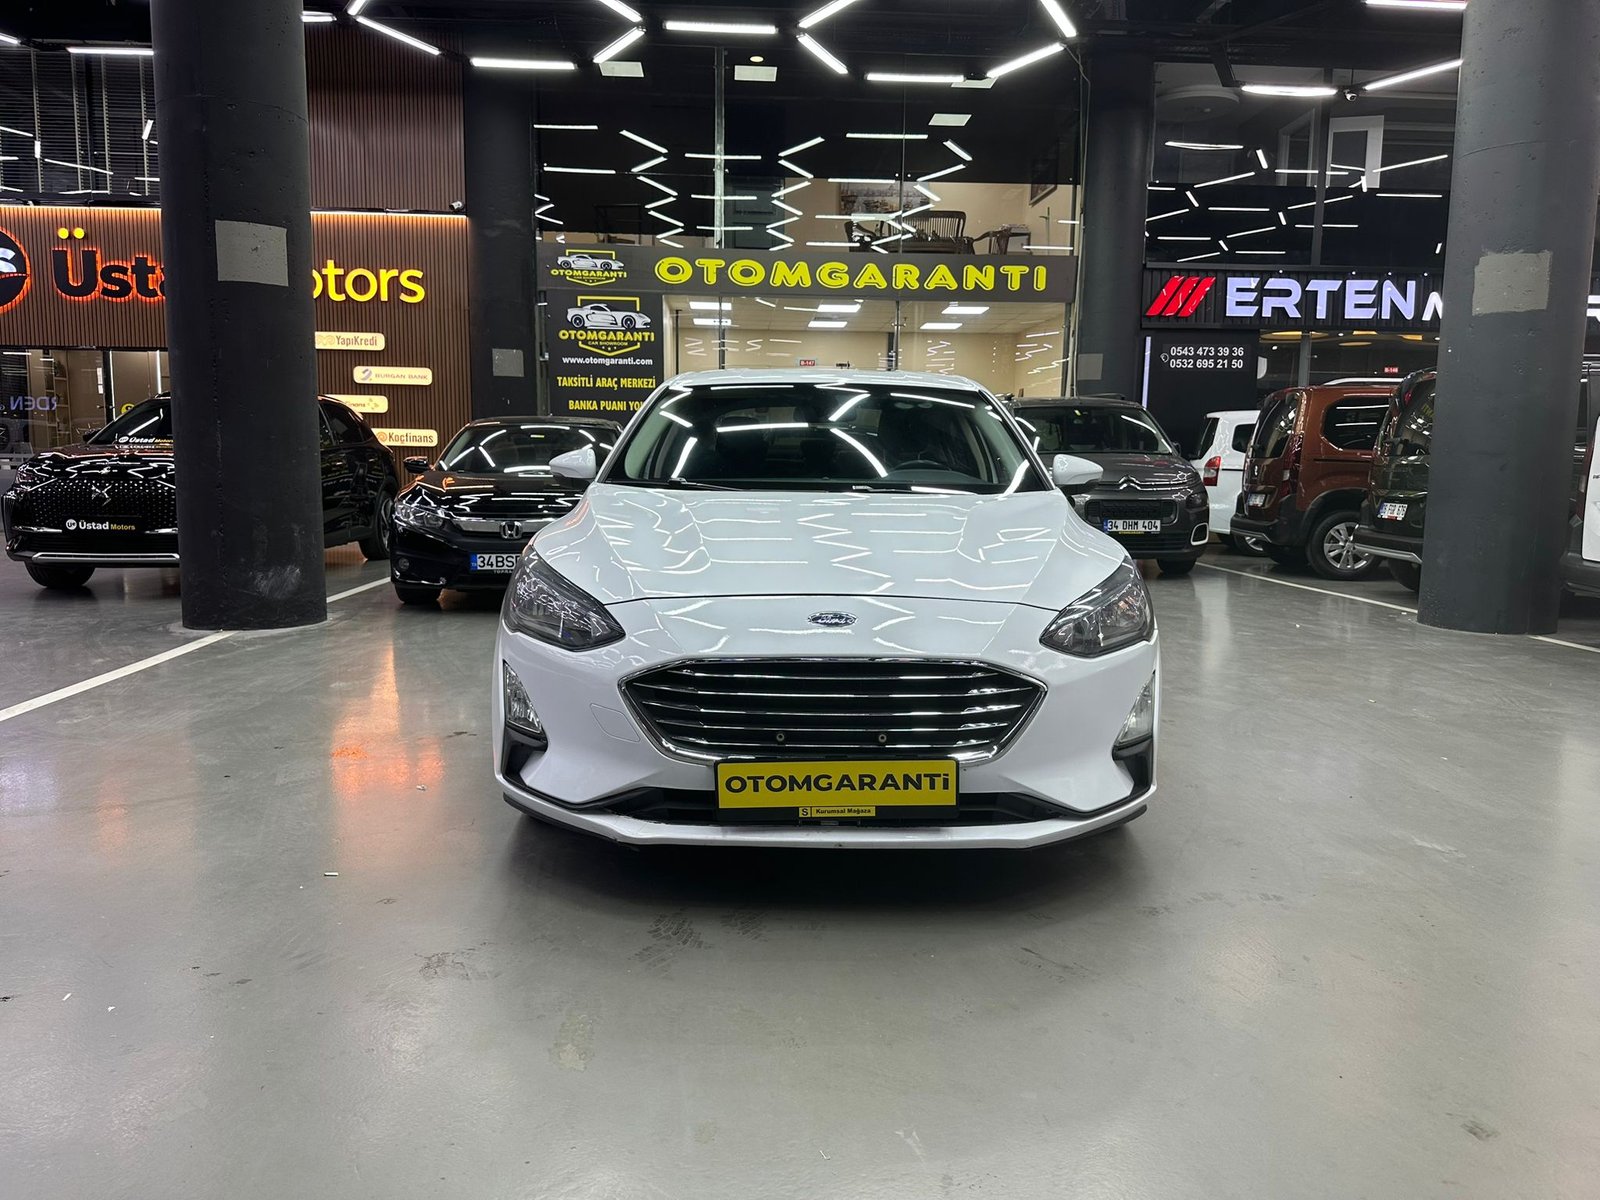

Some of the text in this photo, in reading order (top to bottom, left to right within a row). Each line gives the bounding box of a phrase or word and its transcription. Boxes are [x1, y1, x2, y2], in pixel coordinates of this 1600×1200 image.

[52, 227, 165, 300] Üst
[550, 268, 627, 278] OTOMGARANTI
[654, 256, 1047, 292] OTOMGARANTI
[1226, 276, 1416, 320] ERTEN
[558, 329, 655, 341] OTOMGARANTI
[1170, 346, 1244, 356] 0543 473 39 36
[562, 356, 653, 365] www.otomgaranti.com
[1169, 359, 1243, 368] 0532 695 21 50
[557, 374, 656, 390] TAKSİTLİ ARAÇ MERKEZİ
[568, 400, 598, 411] BANKA
[600, 400, 627, 411] PUANI
[79, 520, 109, 530] Üstad
[1108, 520, 1158, 530] 34 DHM 404
[815, 807, 845, 815] Kurumsal
[847, 807, 871, 815] Mağaza
